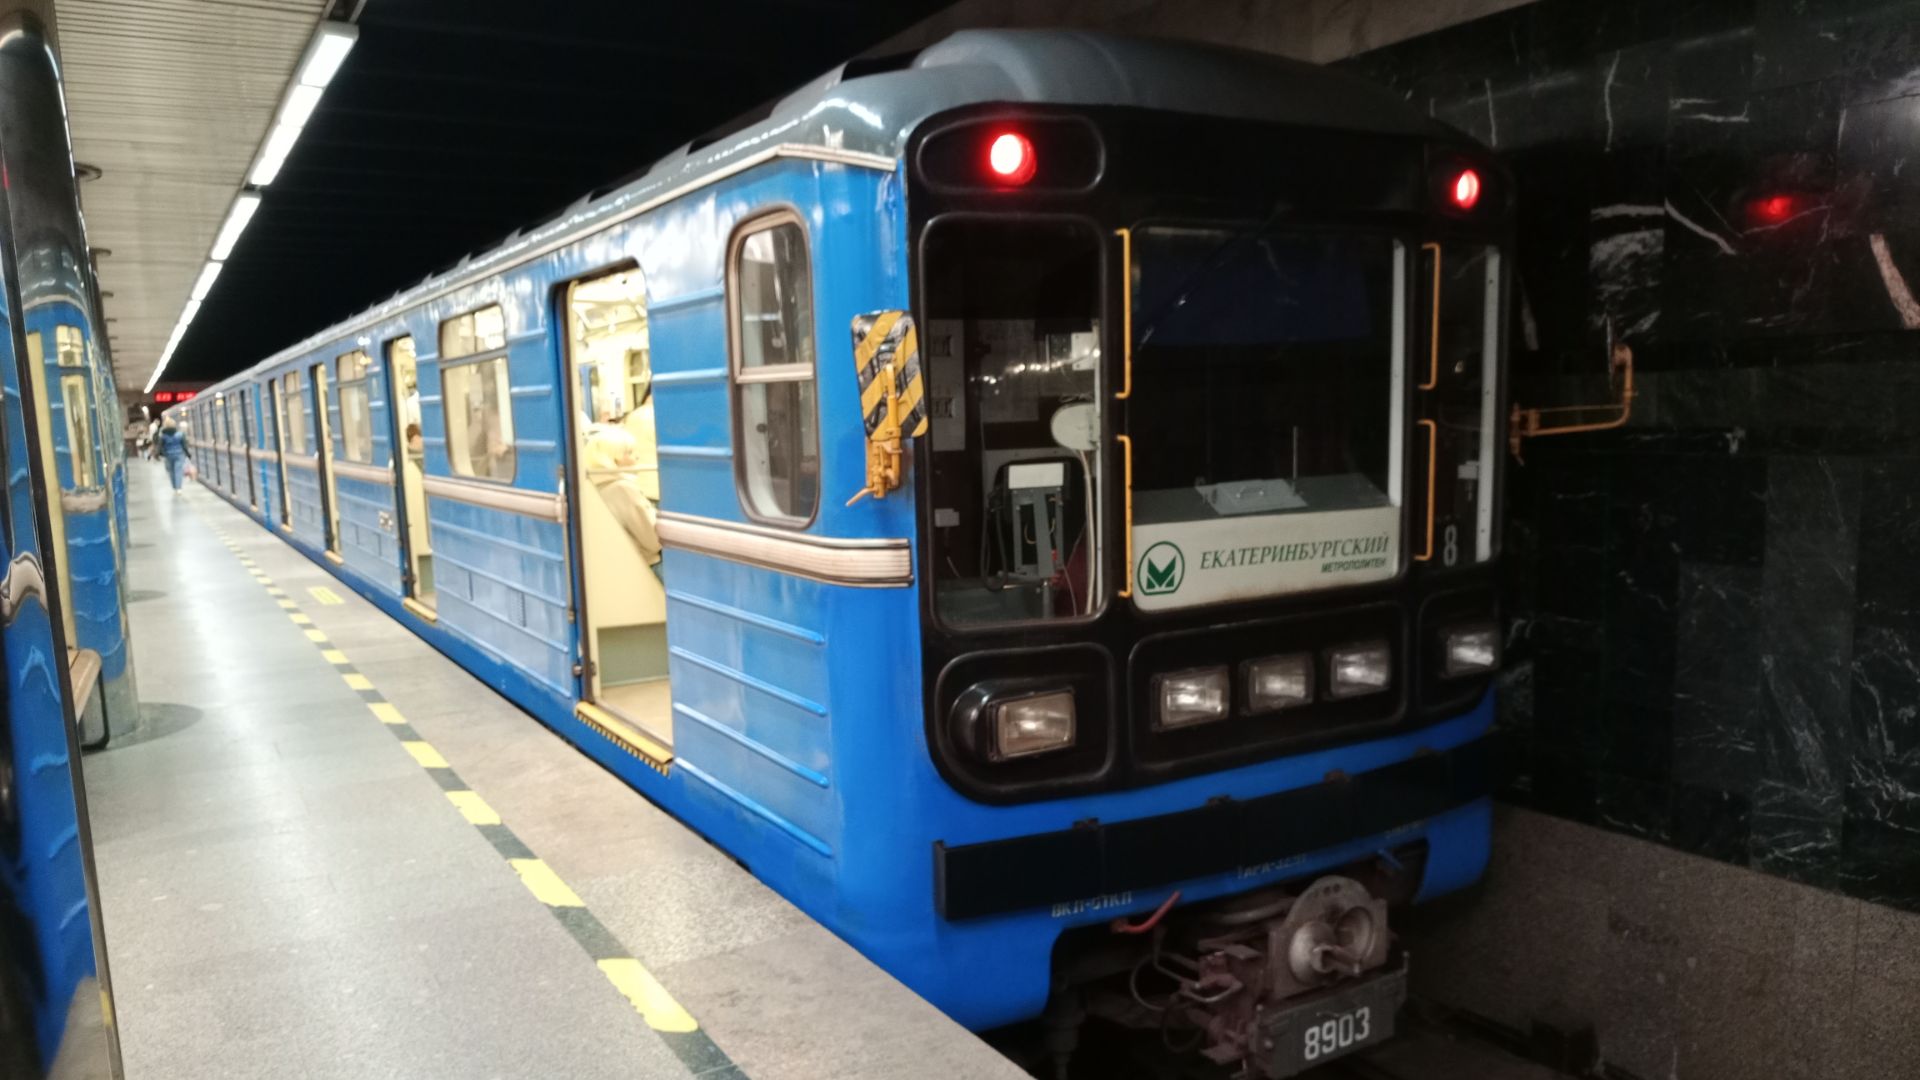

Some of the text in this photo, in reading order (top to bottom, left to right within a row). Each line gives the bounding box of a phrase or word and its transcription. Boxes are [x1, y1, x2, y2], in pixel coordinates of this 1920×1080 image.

[1199, 531, 1390, 570] ЕКАТЕРИНБУРГСКИЙ
[1320, 557, 1387, 573] МЕТРОПОЛИТЕН
[1443, 524, 1459, 568] 8
[1304, 1006, 1370, 1061] 8903
